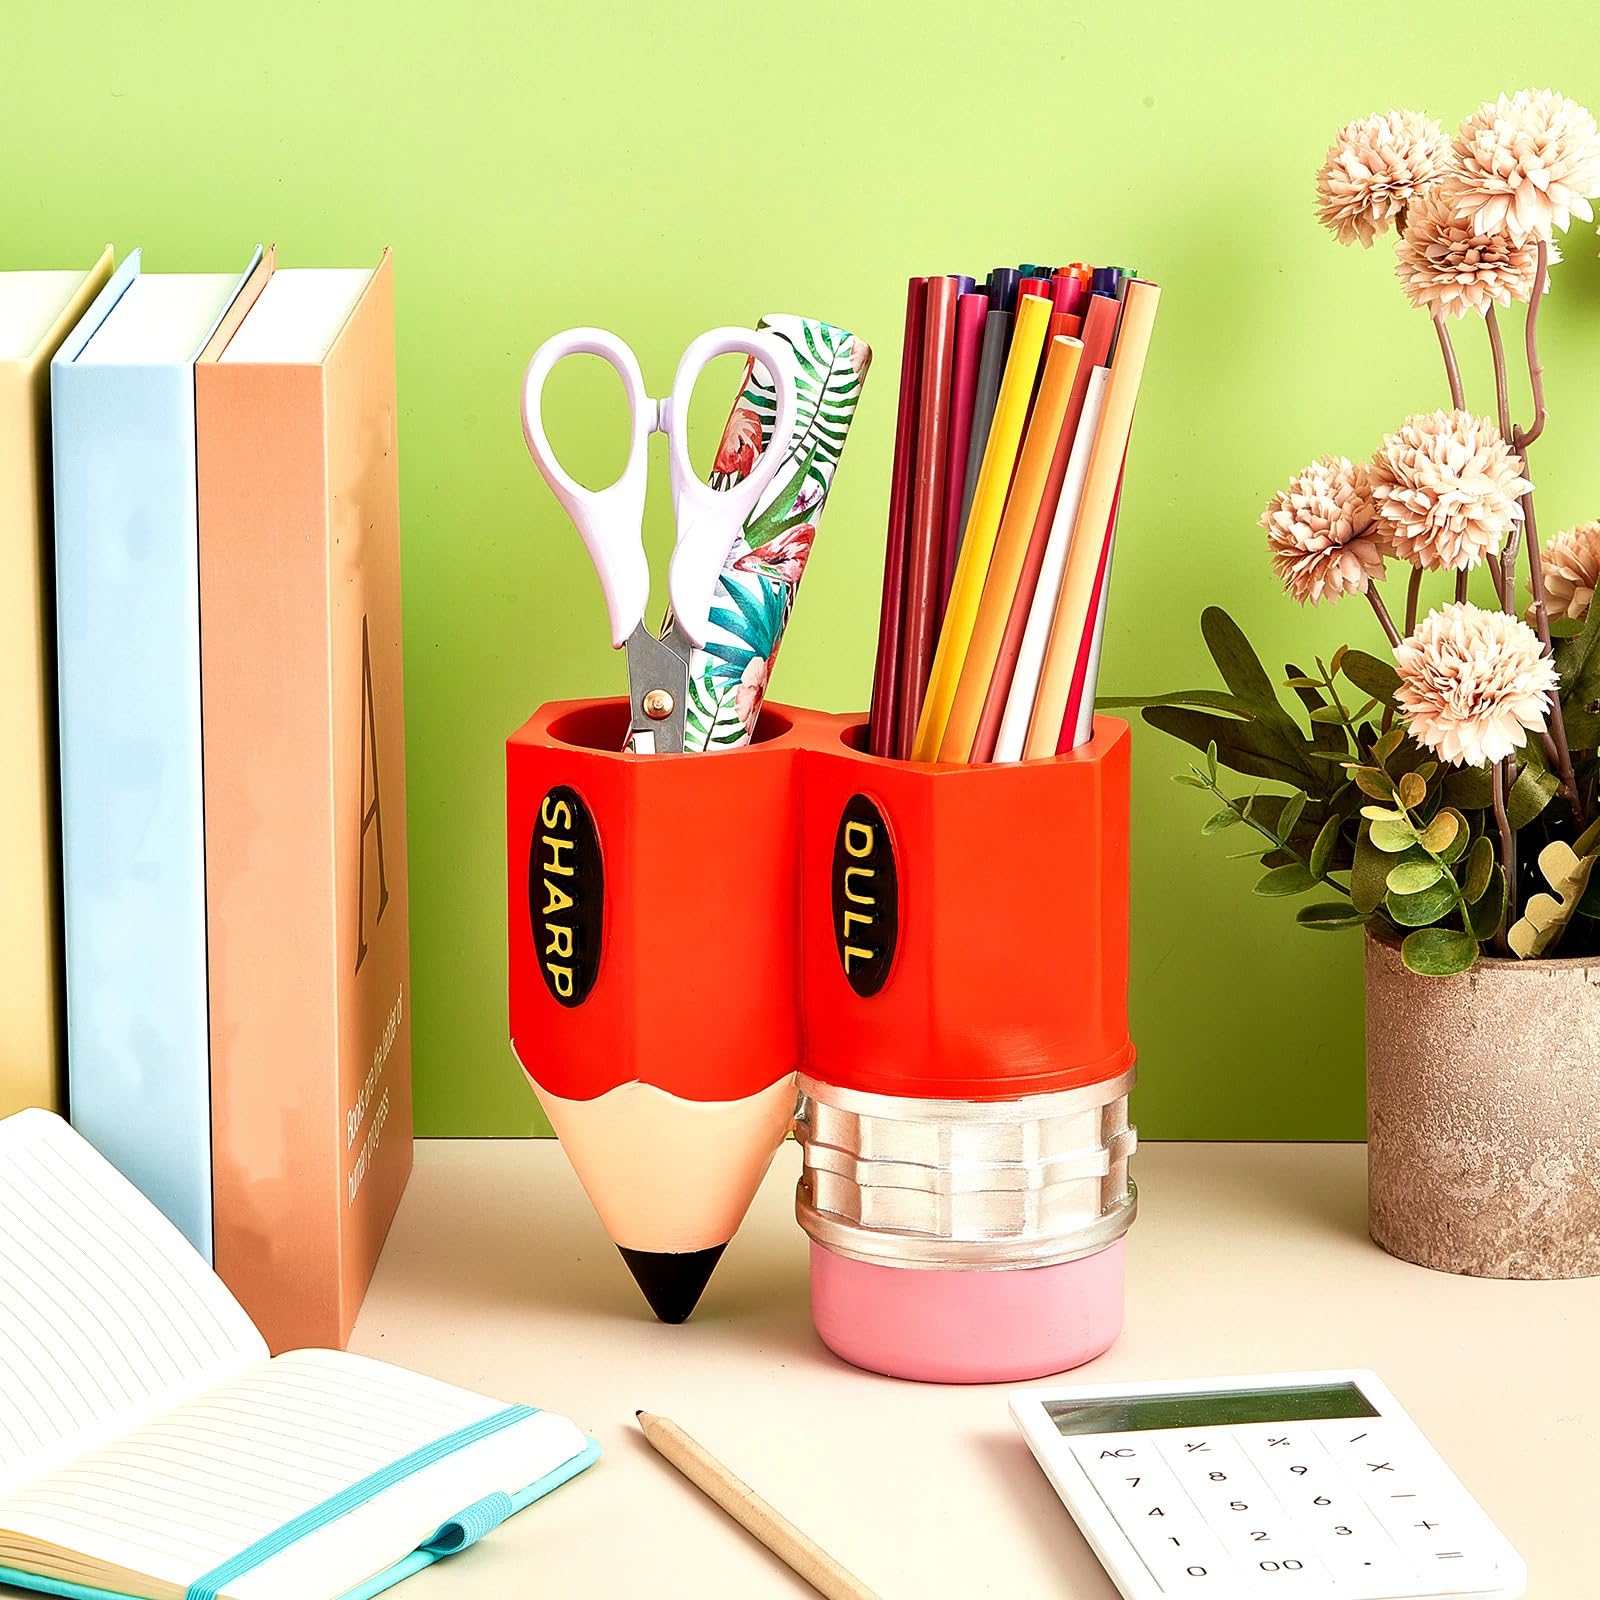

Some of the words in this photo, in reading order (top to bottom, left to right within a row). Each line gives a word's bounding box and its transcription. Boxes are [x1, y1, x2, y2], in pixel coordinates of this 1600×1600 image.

[541, 796, 575, 998] SHARP
[843, 820, 877, 975] DULL
[347, 1089, 365, 1150] Books
[383, 1005, 397, 1063] ladder
[396, 981, 403, 1025] of
[348, 1141, 368, 1208] human
[367, 1086, 390, 1169] progress
[1099, 1448, 1137, 1460] AC
[1125, 1477, 1142, 1488] 7
[1208, 1471, 1228, 1482] 8
[1289, 1465, 1308, 1476] 9
[1147, 1506, 1166, 1517] 4
[1229, 1500, 1250, 1512] 5
[1313, 1495, 1333, 1506] 6
[1167, 1536, 1181, 1547] 1
[1250, 1531, 1271, 1542] 2
[1334, 1525, 1353, 1536] 3
[1186, 1565, 1208, 1577] 0
